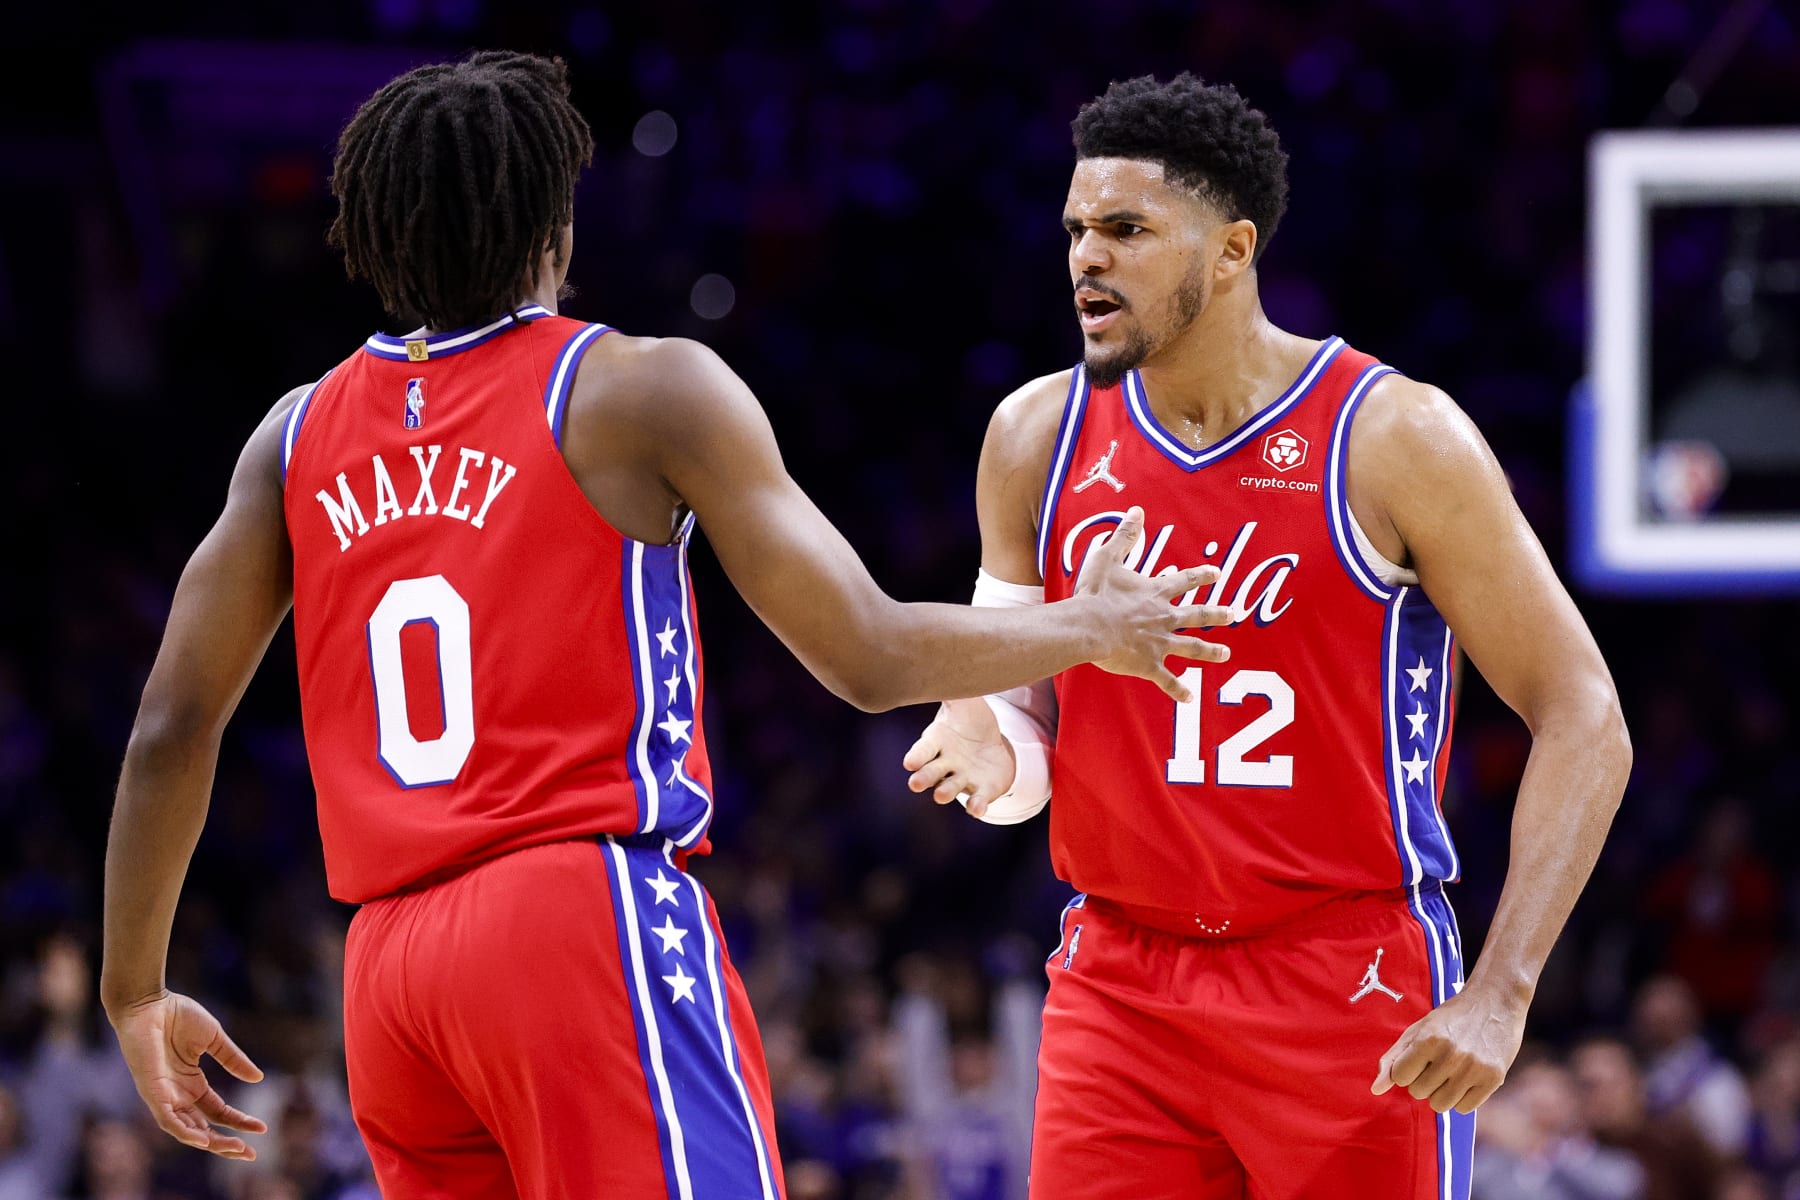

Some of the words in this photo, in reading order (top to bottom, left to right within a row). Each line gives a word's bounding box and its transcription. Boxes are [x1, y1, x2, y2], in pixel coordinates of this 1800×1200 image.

[315, 445, 517, 552] MAXEY
[1240, 475, 1318, 493] crypto.com
[366, 574, 475, 789] 0
[1166, 667, 1295, 788] 12
